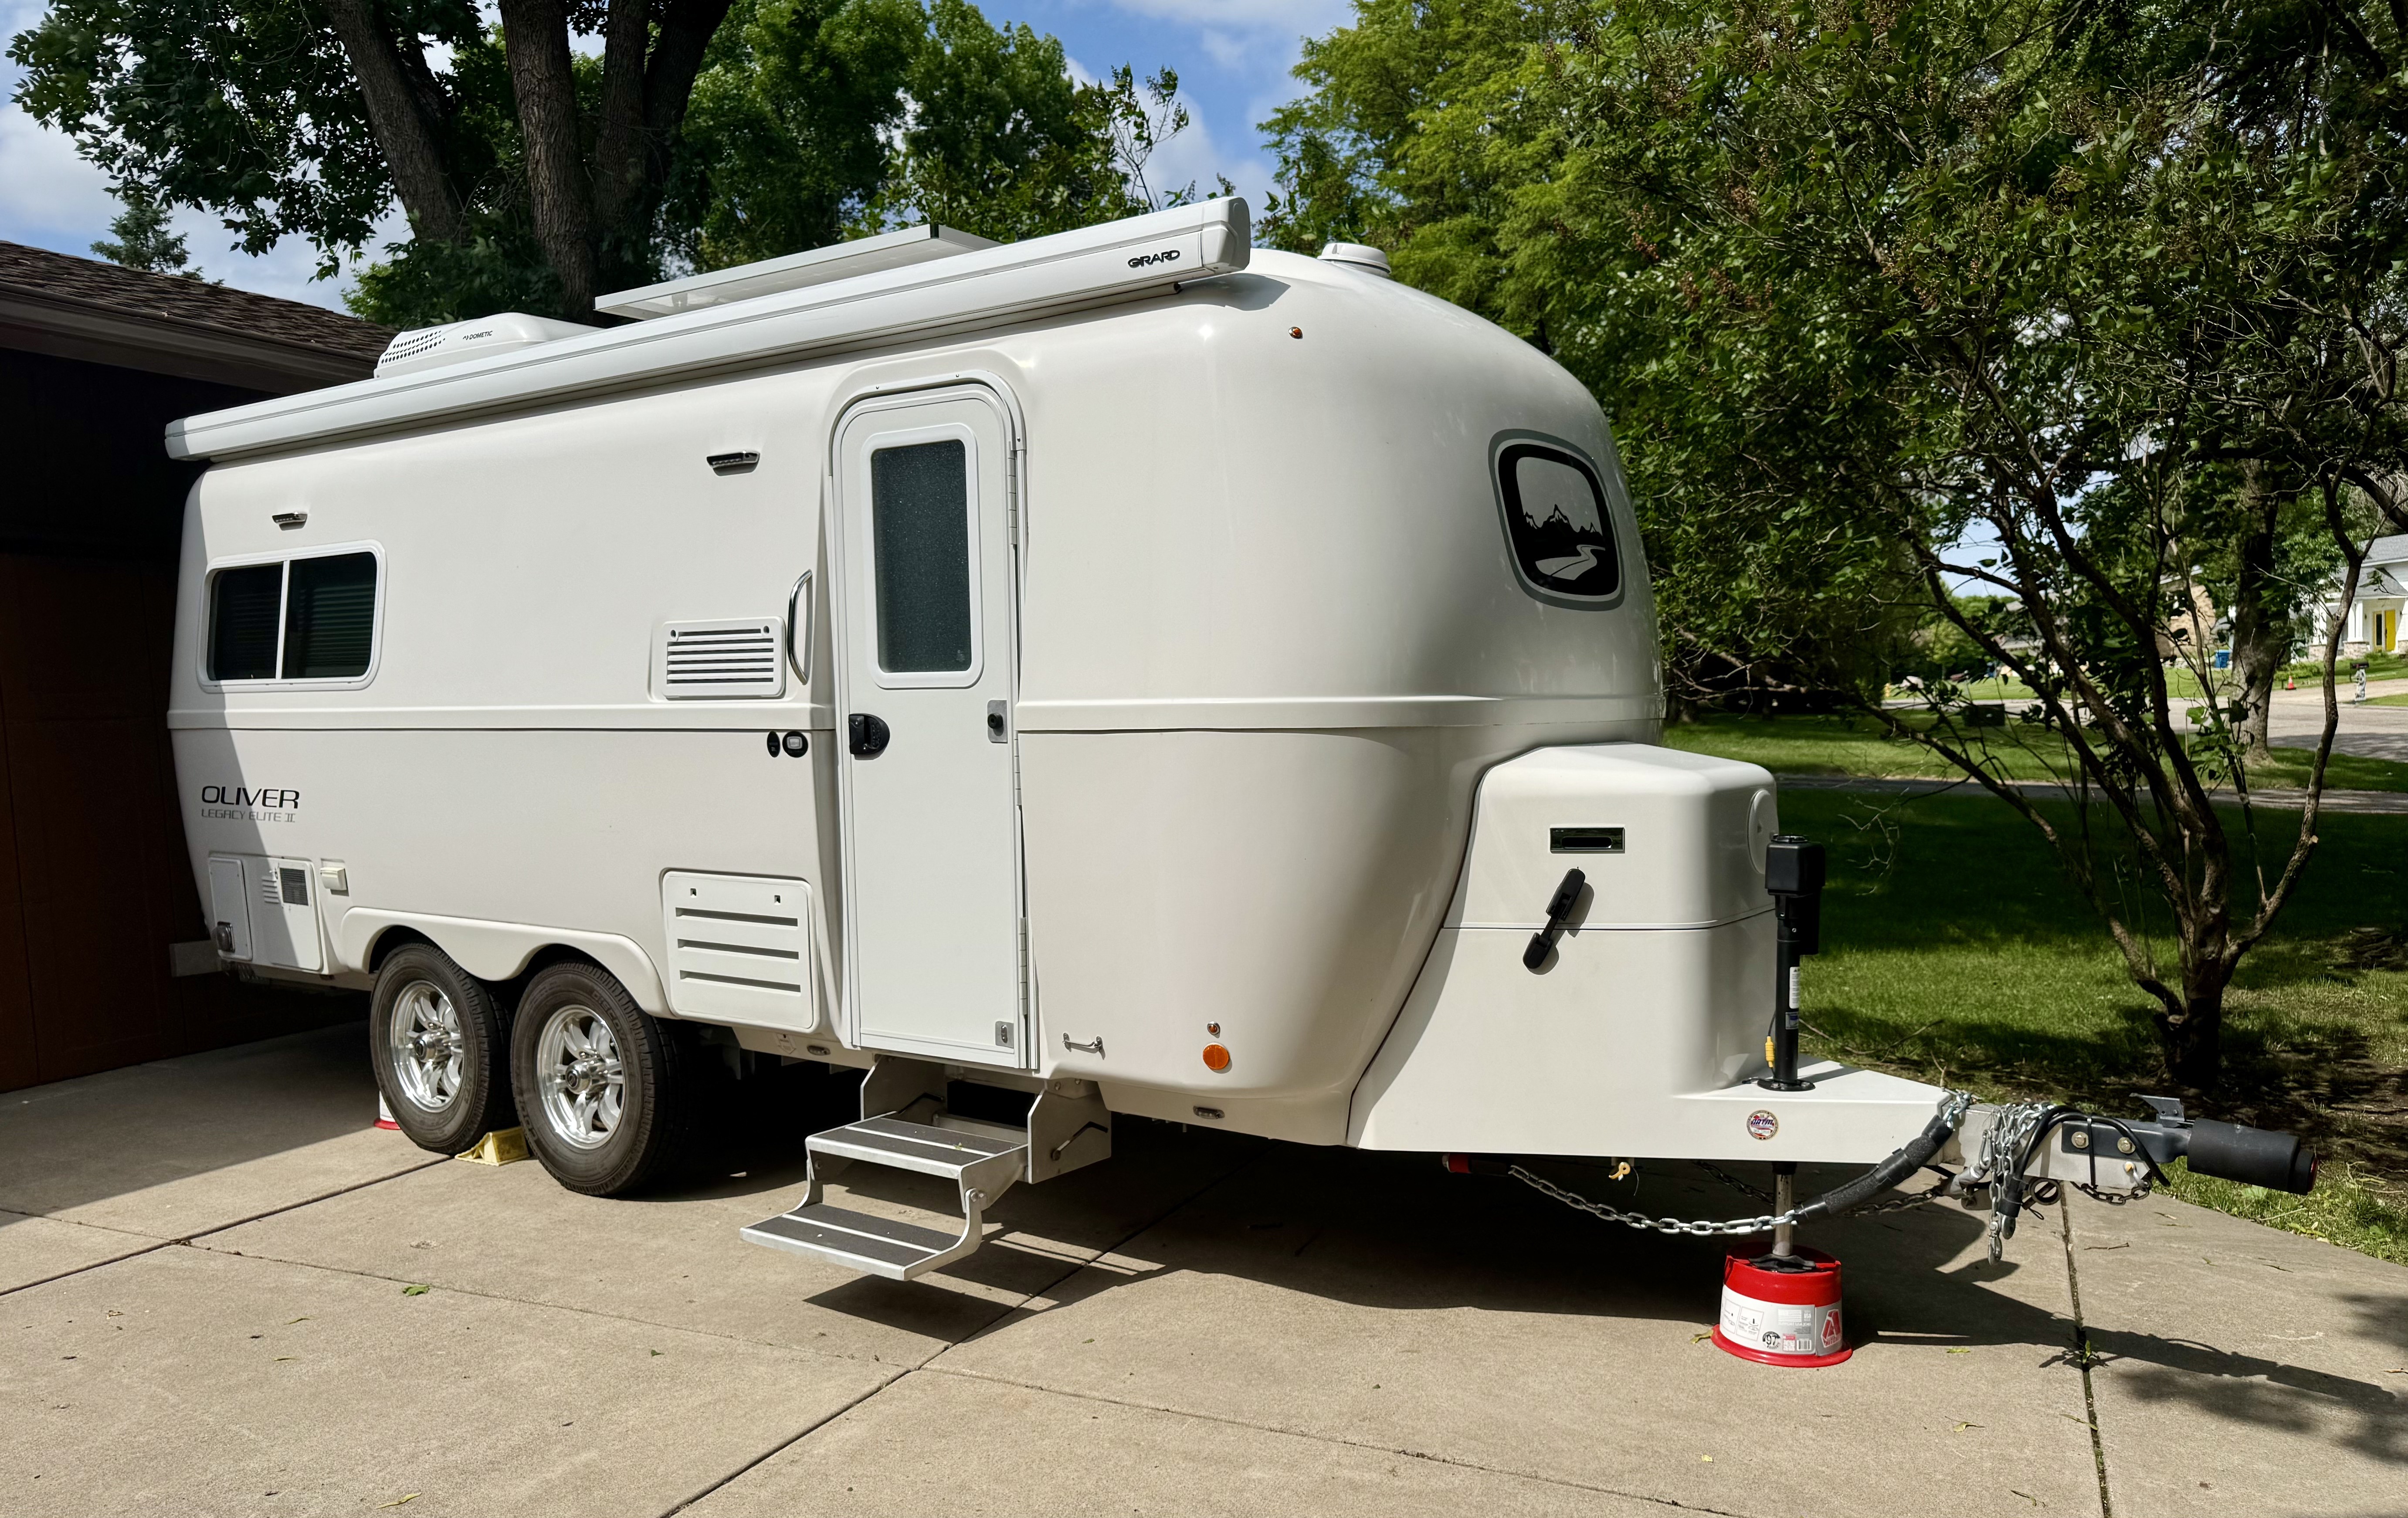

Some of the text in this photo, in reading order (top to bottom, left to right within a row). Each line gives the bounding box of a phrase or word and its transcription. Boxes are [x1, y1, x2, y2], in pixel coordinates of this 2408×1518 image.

[1127, 250, 1180, 268] GIRARD
[469, 330, 493, 340] DOMETIC
[202, 786, 300, 809] OLIVER
[201, 808, 296, 823] LEGACY ELITE II
